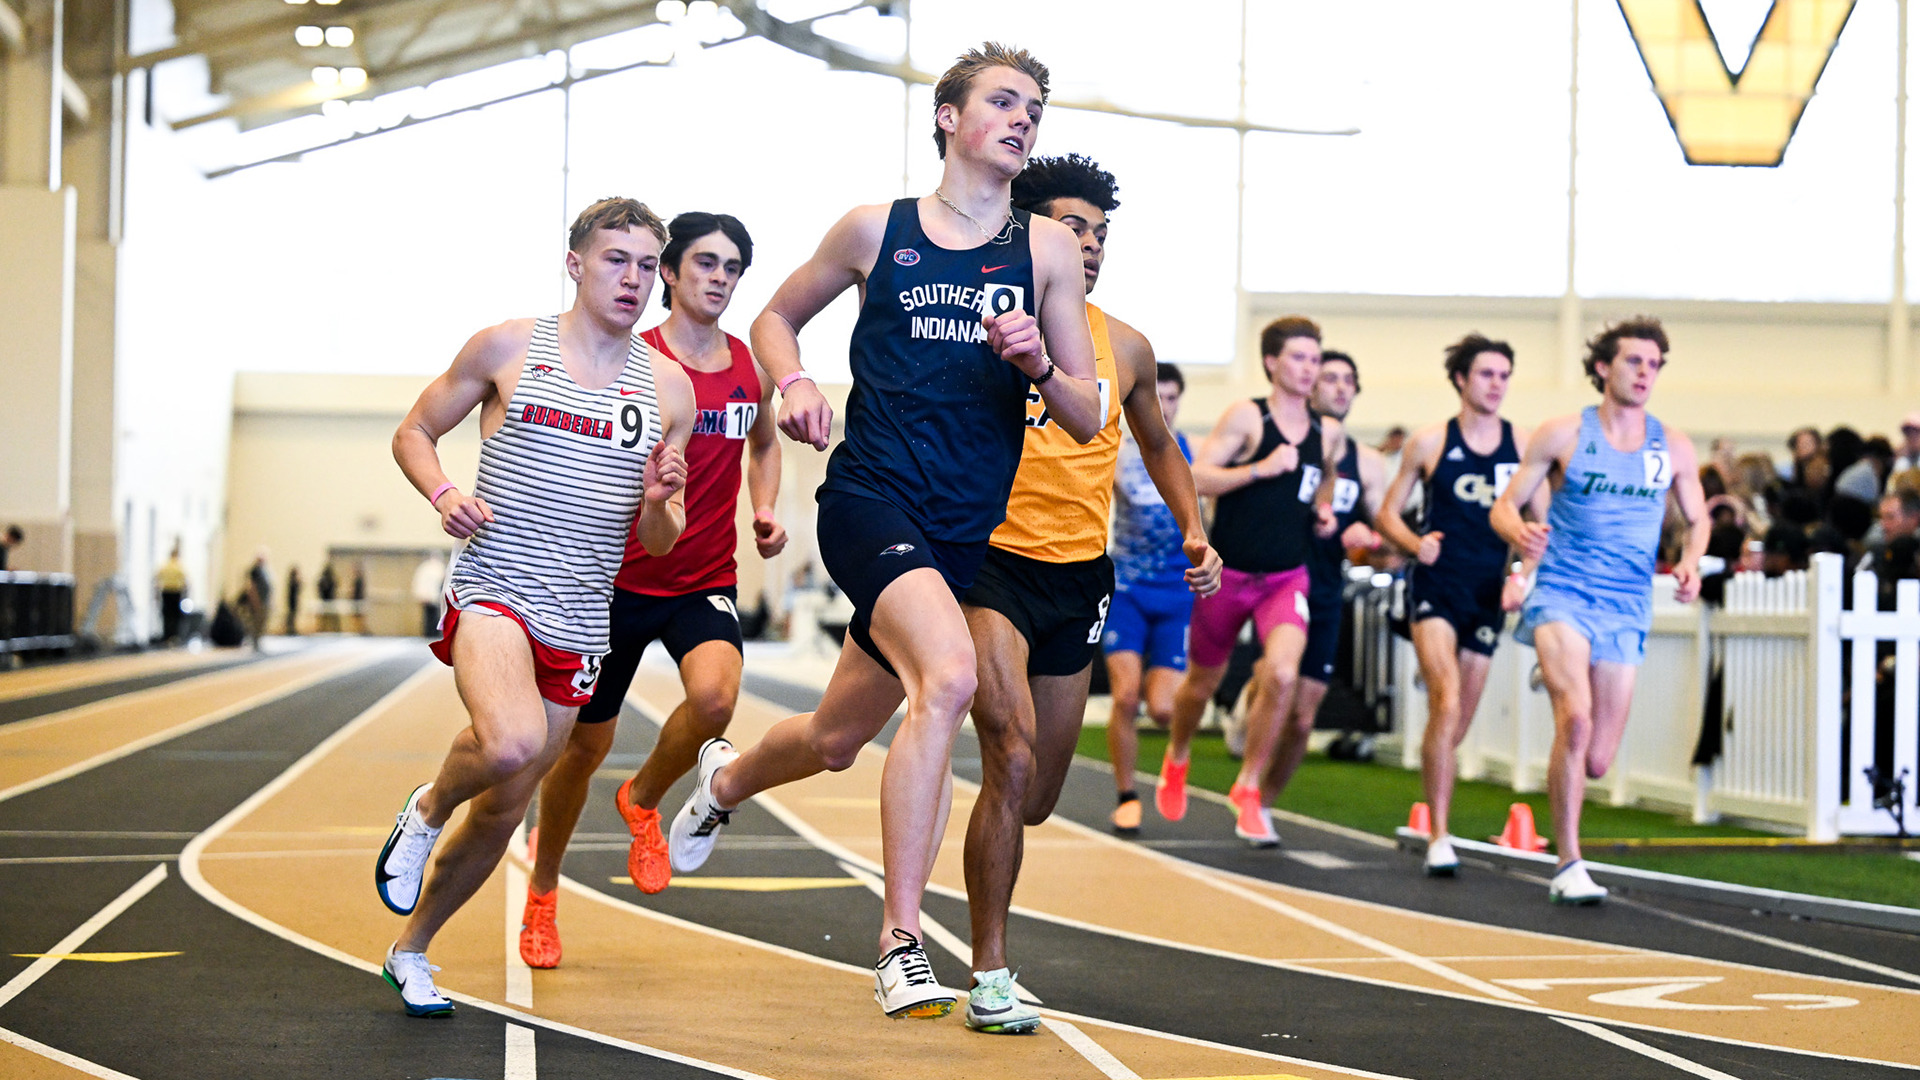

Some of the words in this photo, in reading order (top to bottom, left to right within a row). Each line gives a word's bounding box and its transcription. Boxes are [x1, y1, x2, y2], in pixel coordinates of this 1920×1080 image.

[911, 316, 982, 344] INDIANA
[521, 403, 613, 441] CUMBERLA
[620, 404, 643, 449] 9
[734, 404, 755, 437] 10
[1651, 454, 1664, 483] 2
